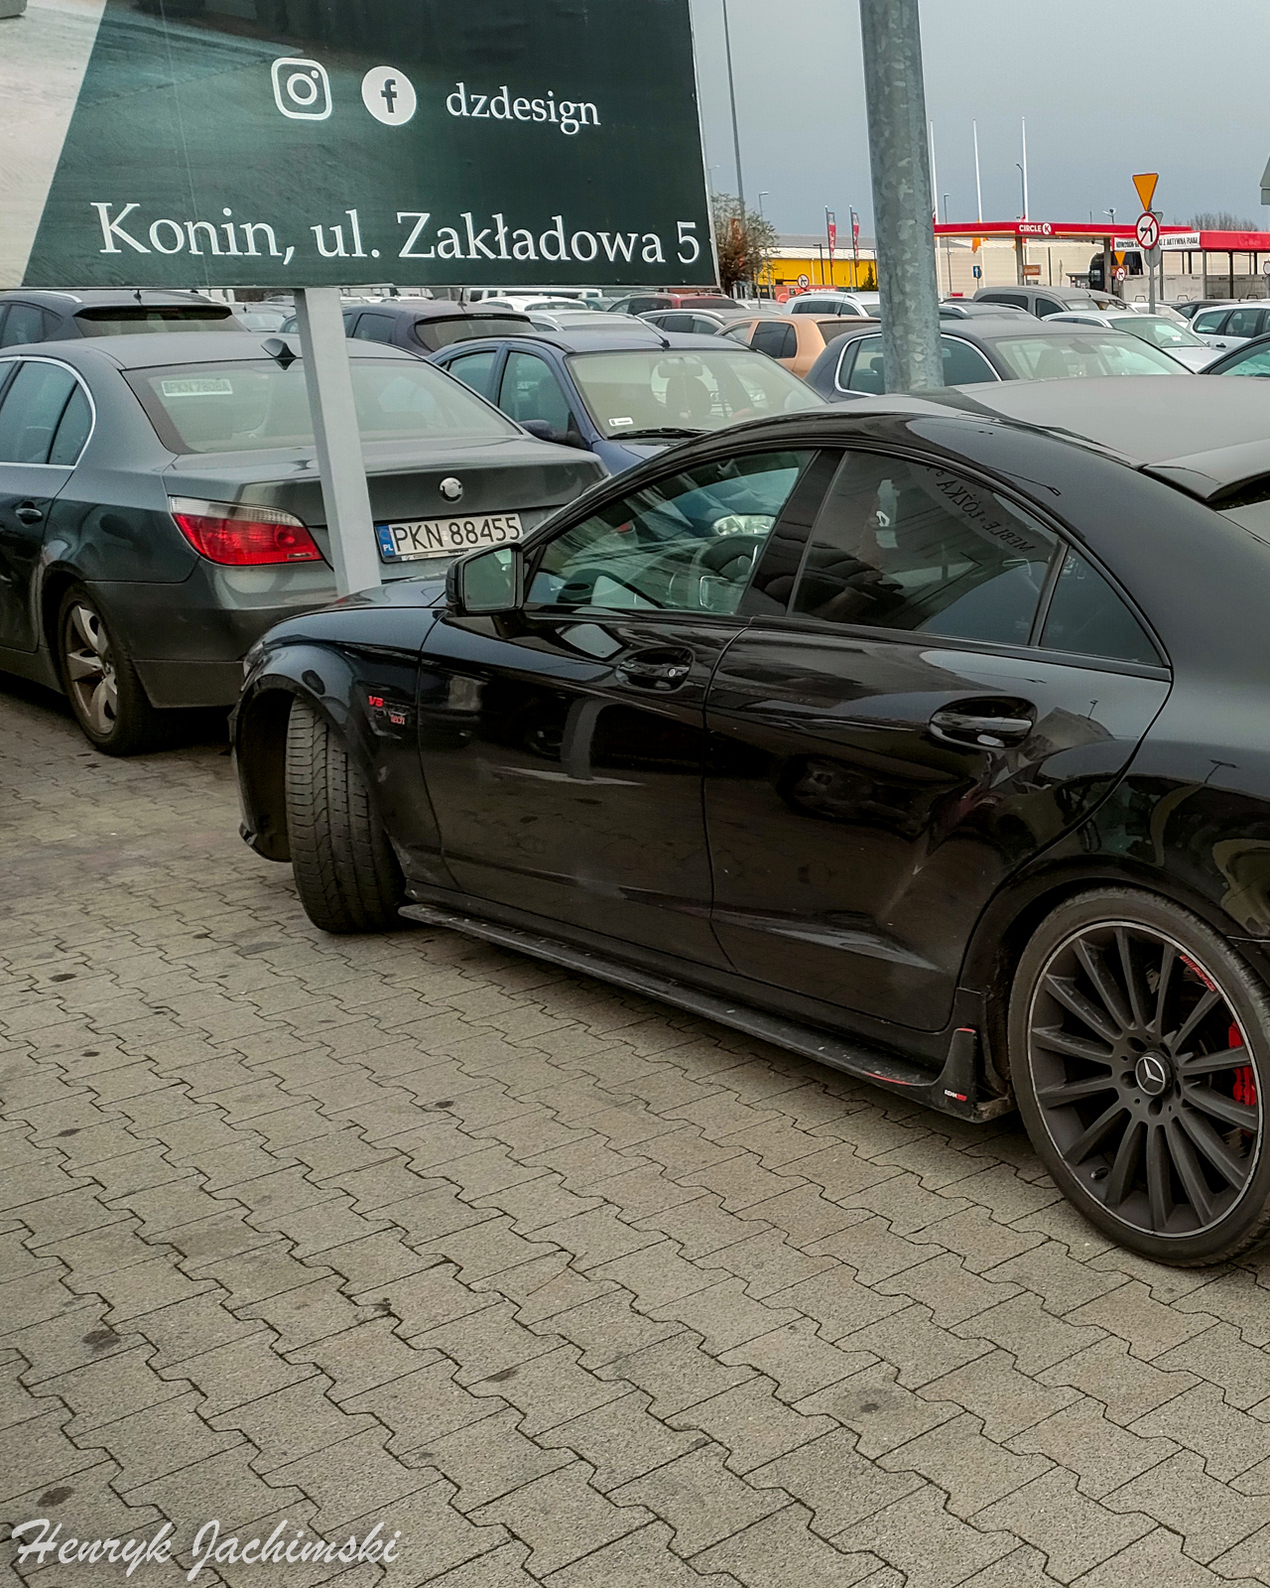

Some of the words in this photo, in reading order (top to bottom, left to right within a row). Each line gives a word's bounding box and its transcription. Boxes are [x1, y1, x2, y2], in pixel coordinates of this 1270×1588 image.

[446, 82, 601, 135] dzdesign
[90, 202, 295, 265] Konin,
[310, 208, 380, 258] ul.
[397, 211, 666, 263] Zakładowa
[676, 221, 700, 264] 5
[1019, 224, 1042, 232] CIRCLE
[392, 523, 444, 552] PKN
[448, 517, 520, 545] 88455
